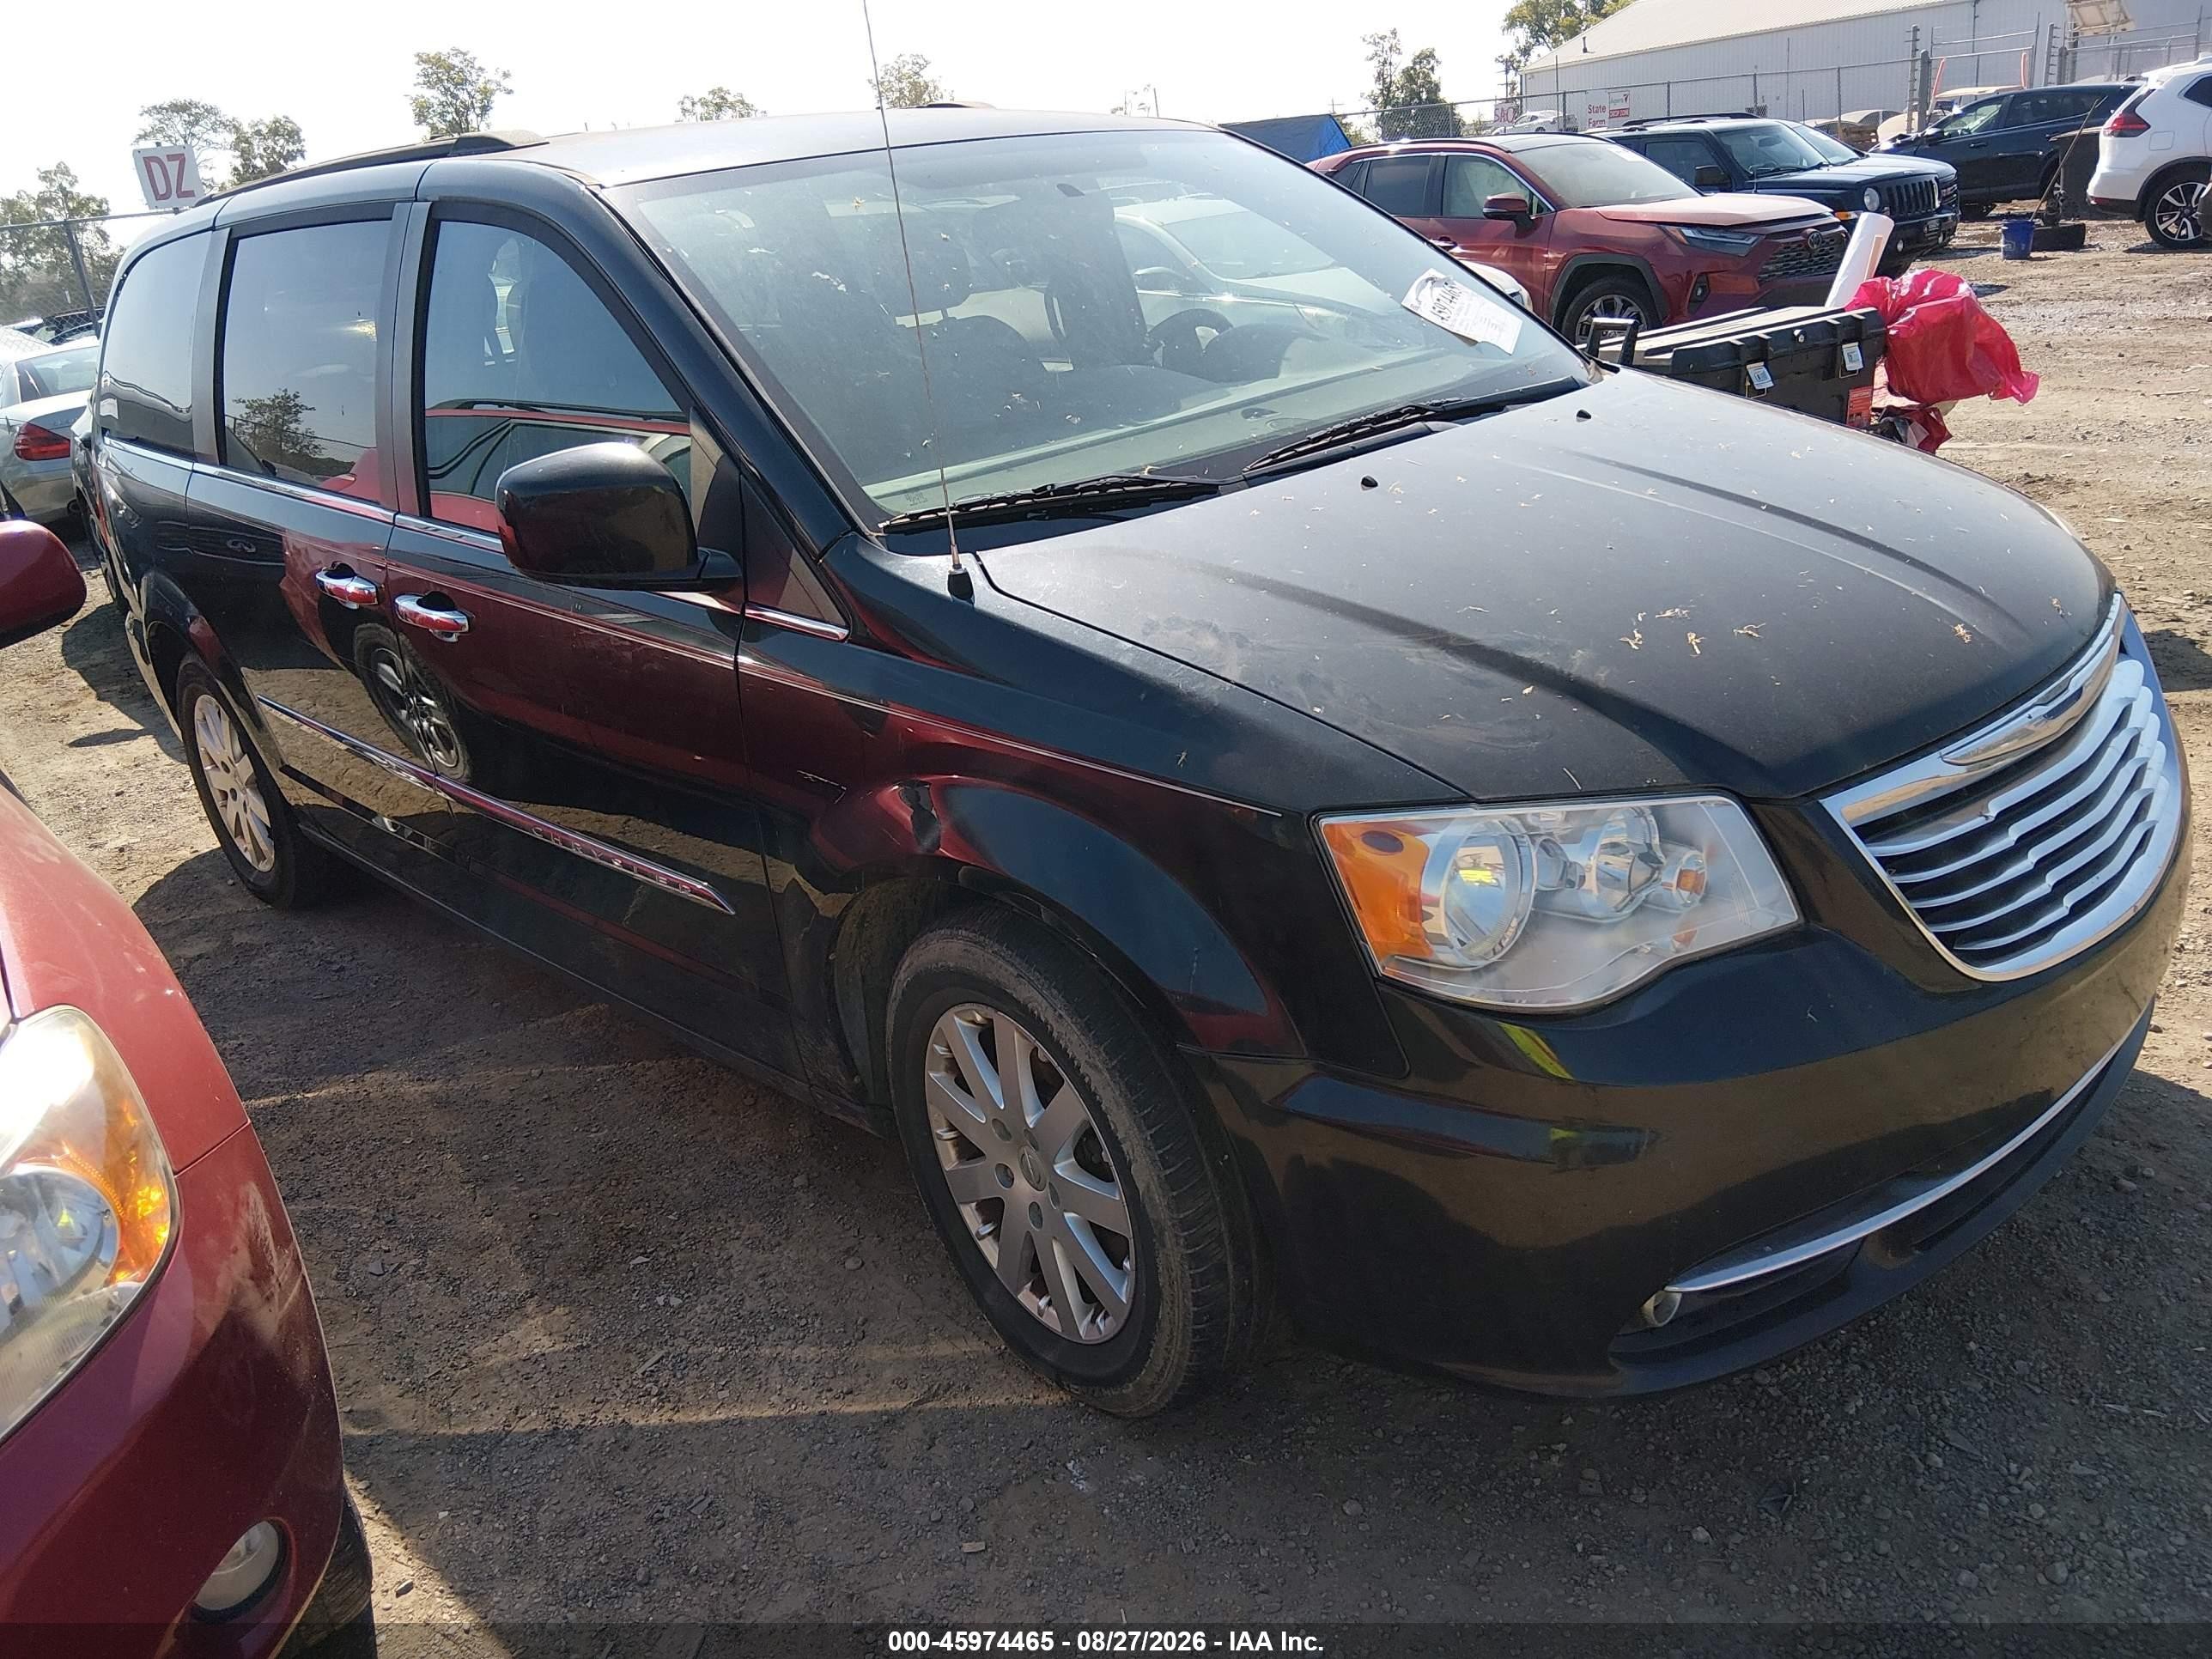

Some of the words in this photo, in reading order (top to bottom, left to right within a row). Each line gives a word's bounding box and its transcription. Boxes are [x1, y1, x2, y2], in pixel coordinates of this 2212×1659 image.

[1588, 103, 1607, 114] State
[1588, 118, 1606, 127] Farm
[143, 153, 196, 201] DZ
[532, 827, 692, 896] CHRYSLER
